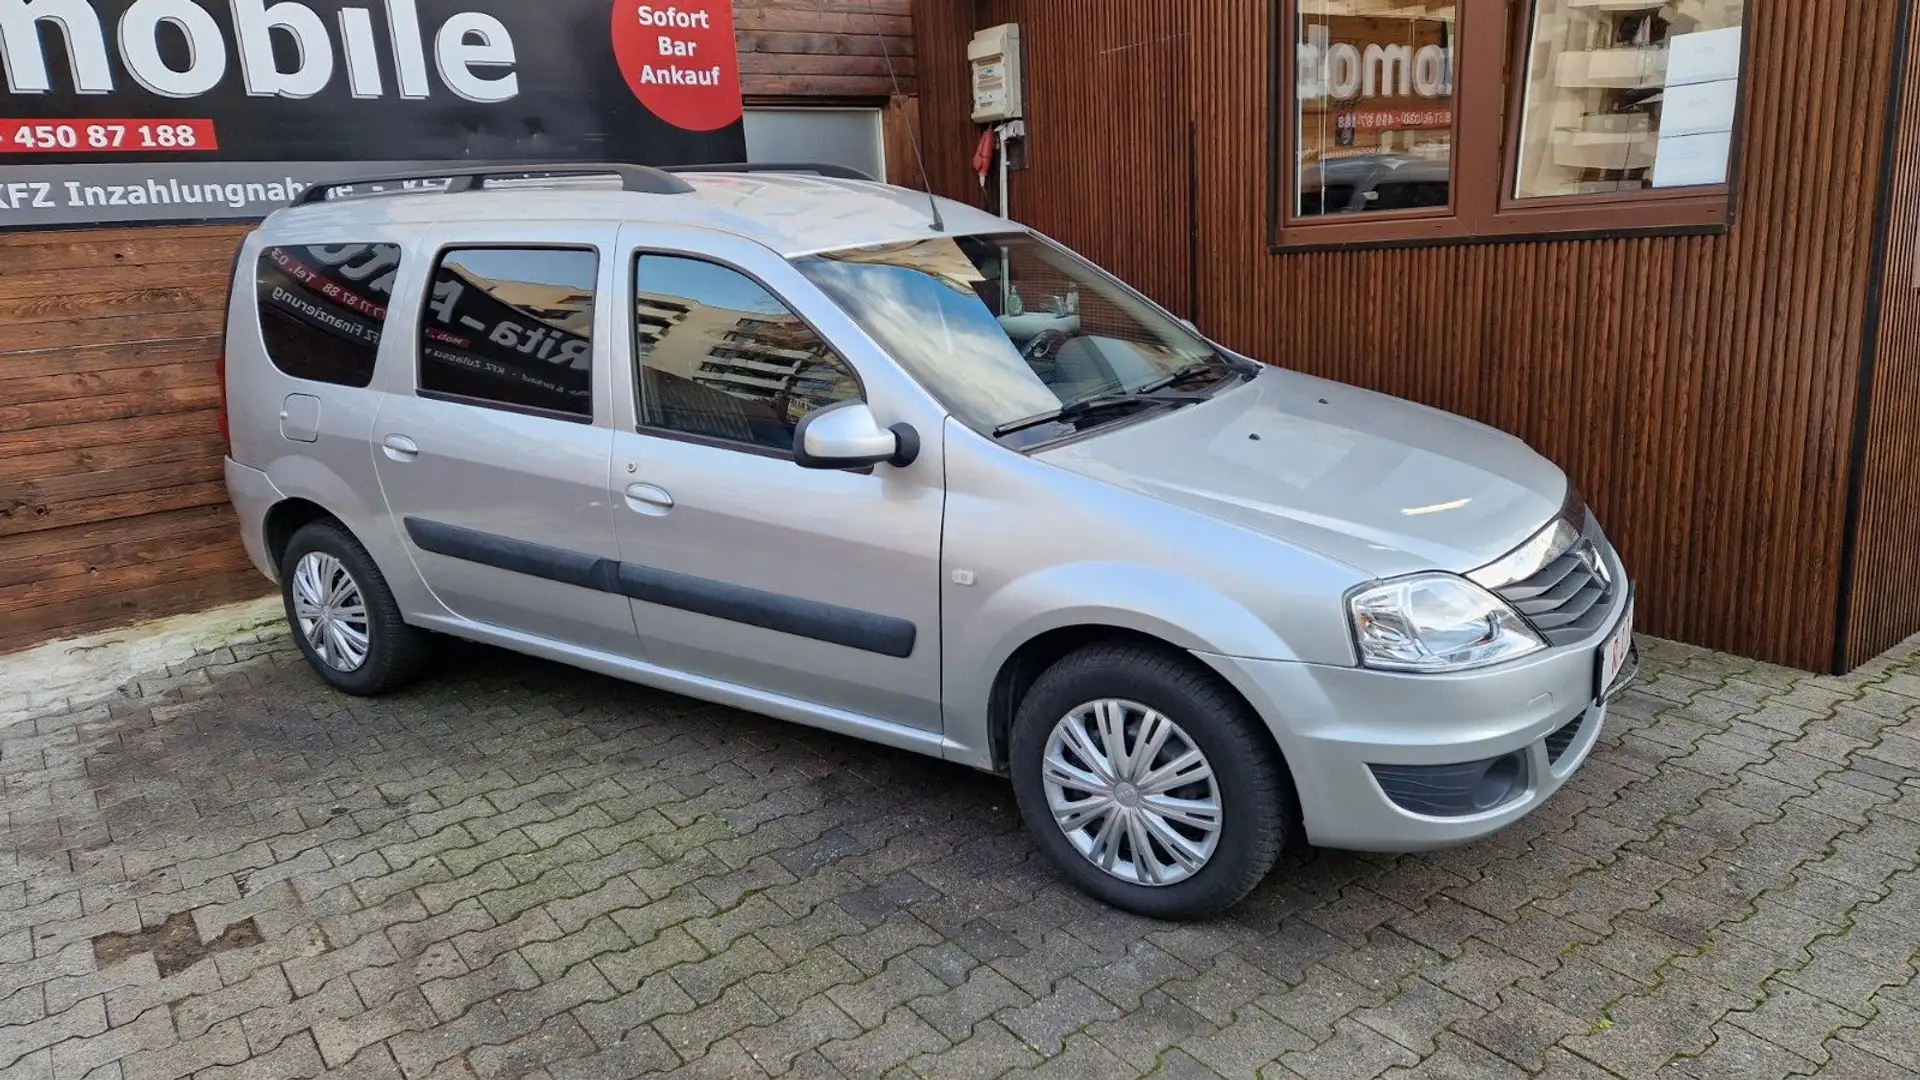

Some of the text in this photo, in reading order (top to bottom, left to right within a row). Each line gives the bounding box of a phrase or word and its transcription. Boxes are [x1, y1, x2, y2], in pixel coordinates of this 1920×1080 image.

[637, 5, 710, 29] Sofort
[657, 35, 698, 57] Bar
[640, 64, 720, 86] Ankauf
[14, 124, 196, 148] 450 87 188
